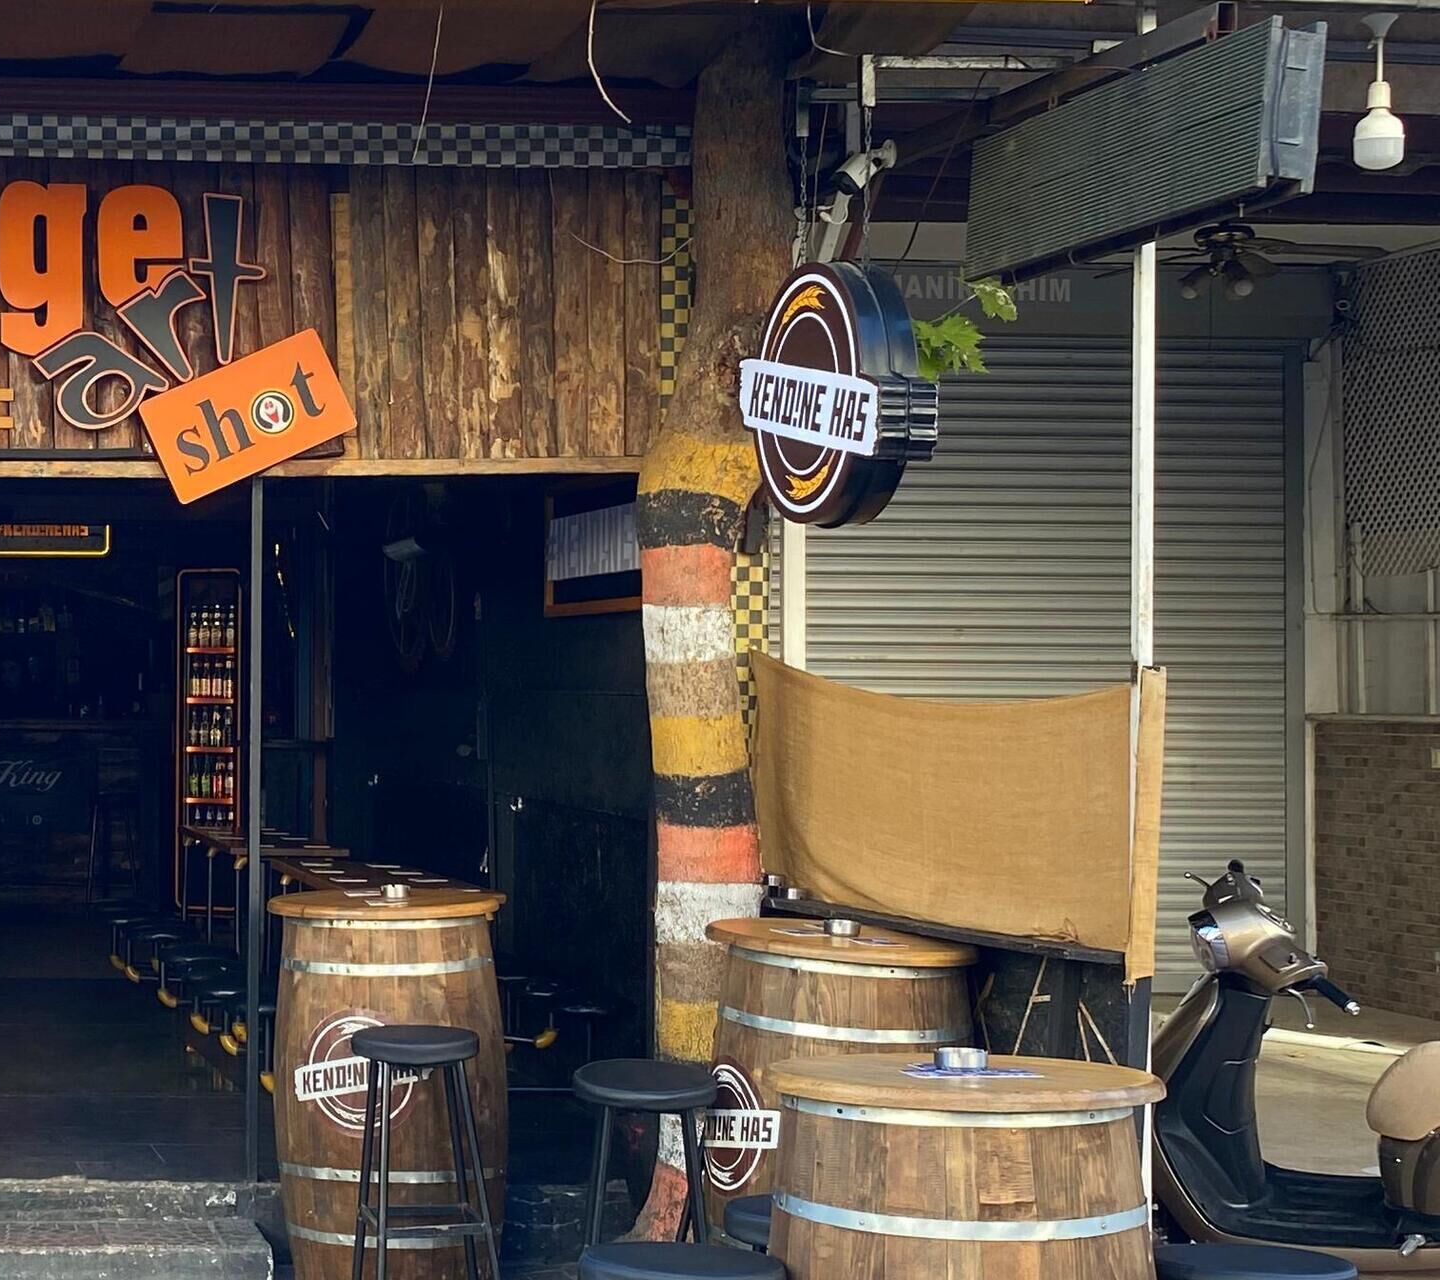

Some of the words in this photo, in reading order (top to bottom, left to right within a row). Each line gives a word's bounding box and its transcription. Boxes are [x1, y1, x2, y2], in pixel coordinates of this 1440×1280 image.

[31, 192, 267, 430] art
[176, 361, 325, 476] shot
[828, 387, 870, 442] HAS
[741, 1117, 773, 1142] HAS
